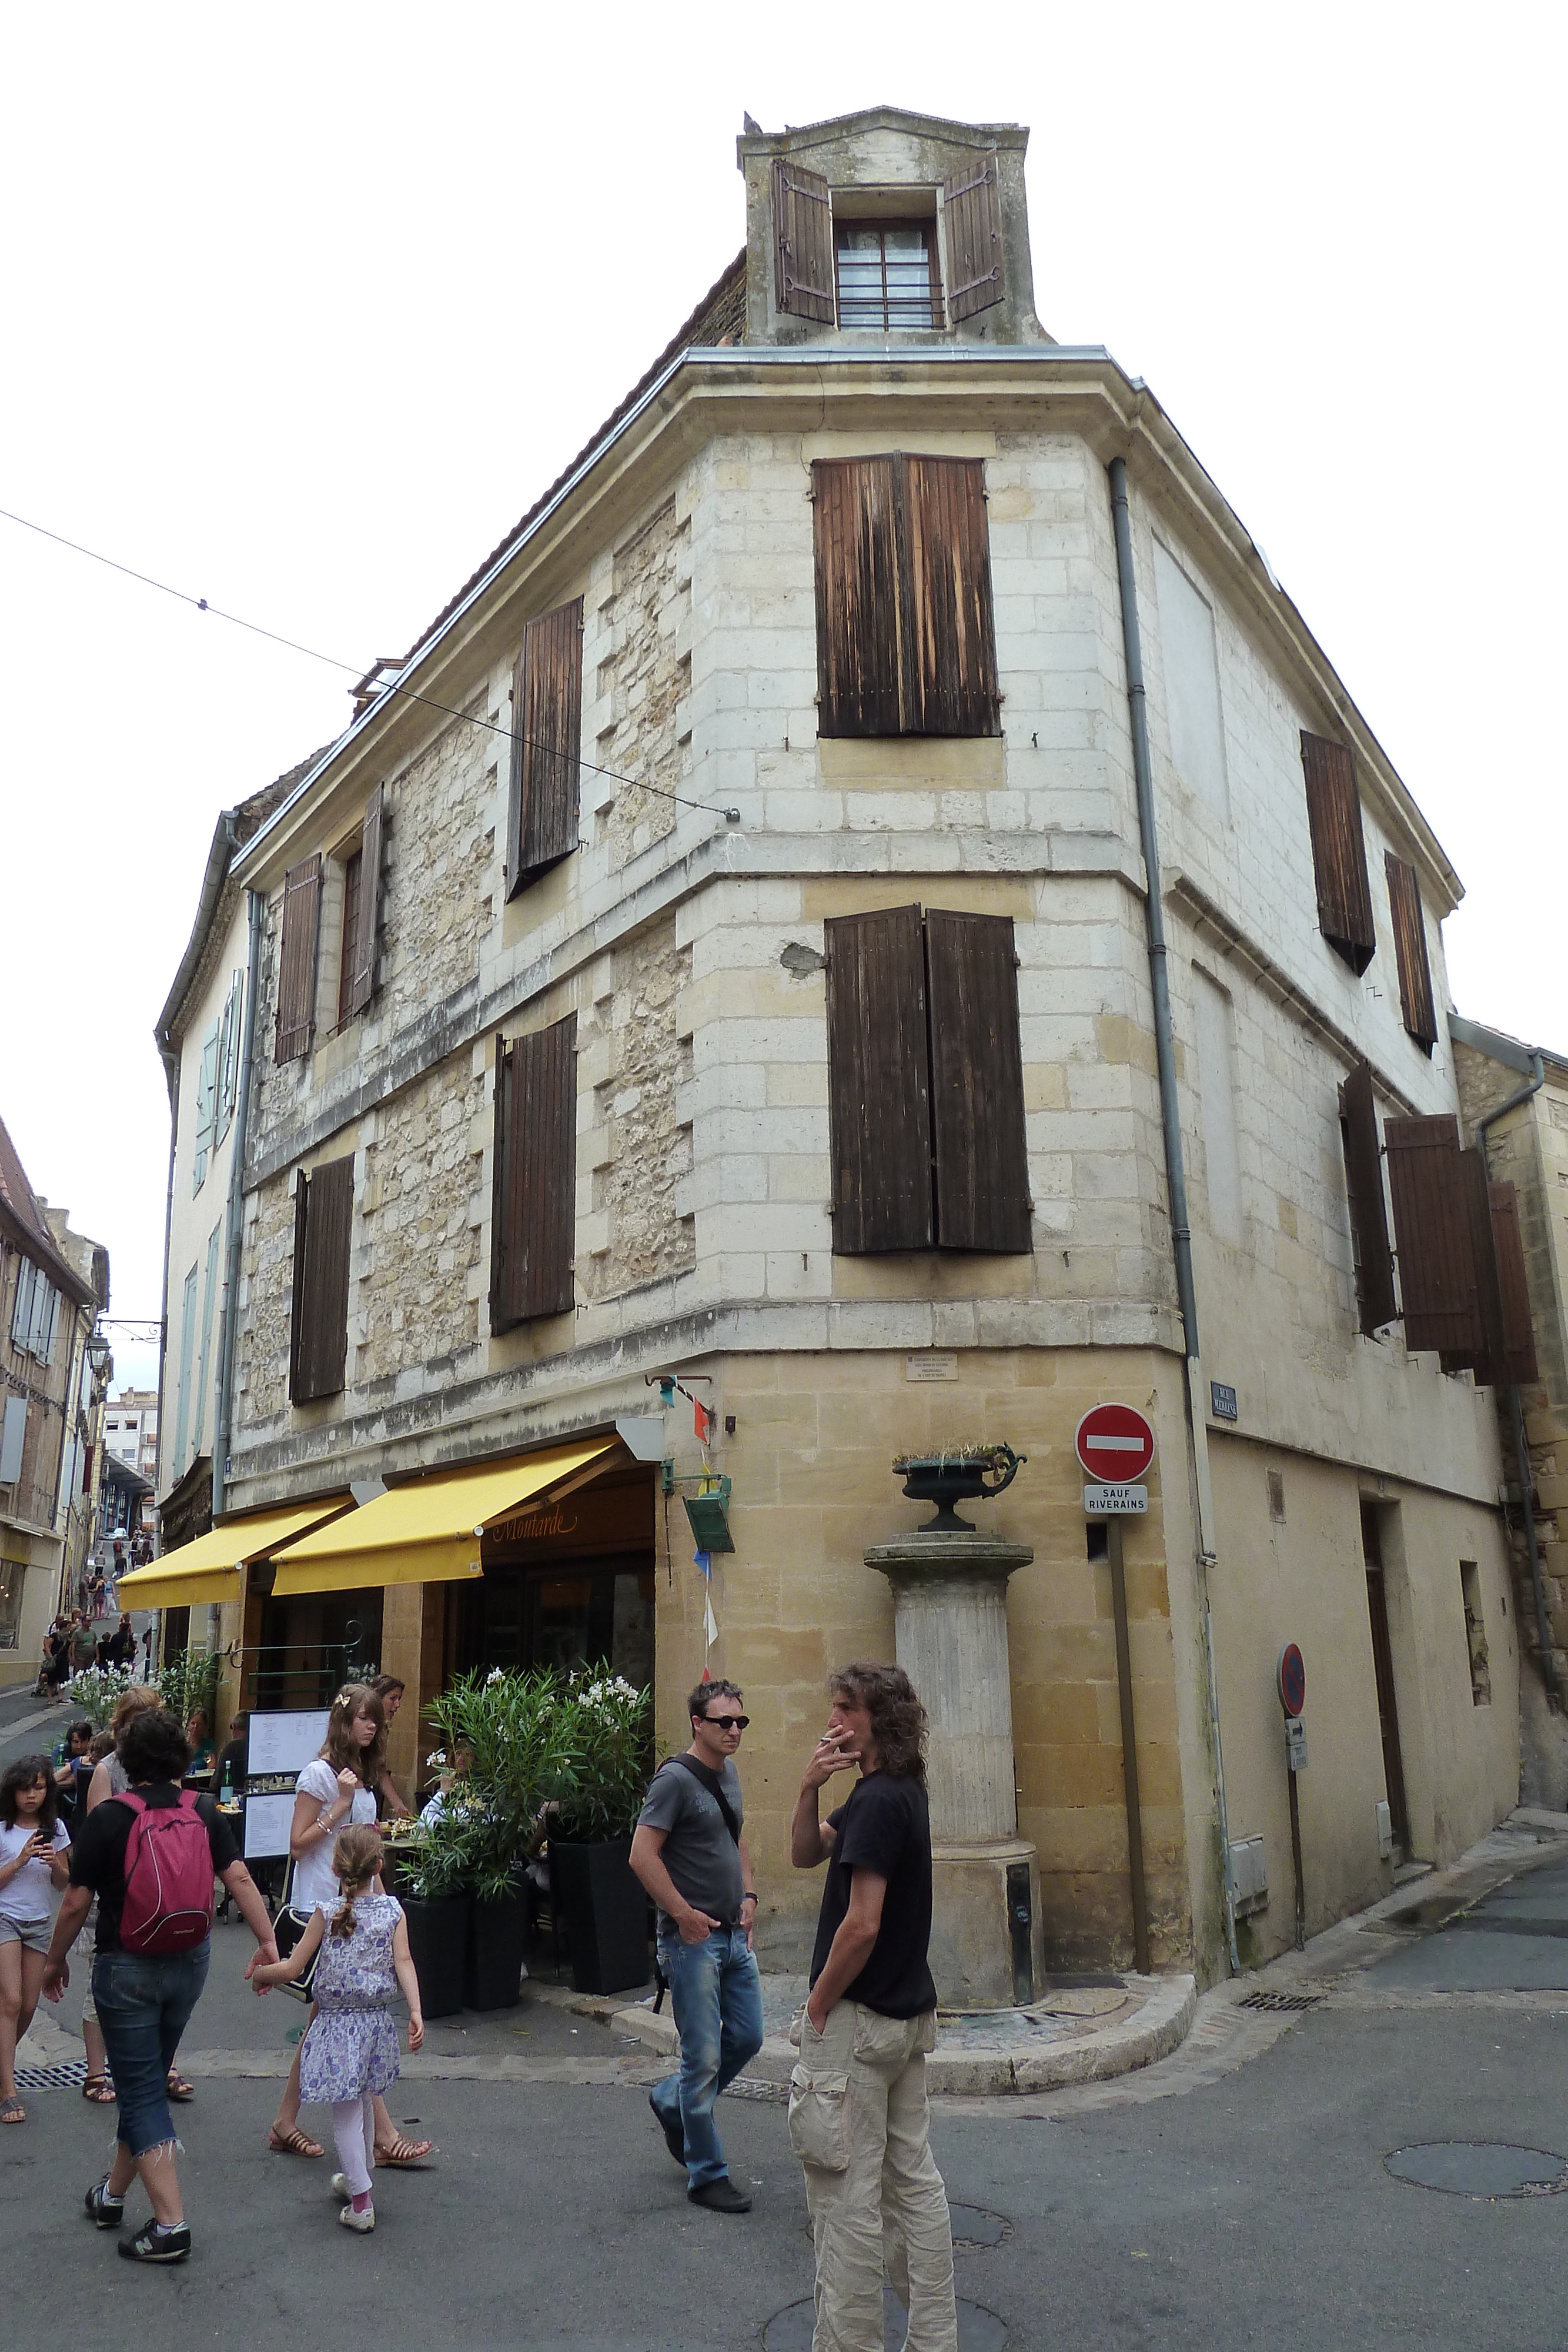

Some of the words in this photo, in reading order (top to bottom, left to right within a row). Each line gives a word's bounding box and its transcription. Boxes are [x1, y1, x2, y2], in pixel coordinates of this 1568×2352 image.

[1219, 1388, 1229, 1399] RUE
[1102, 1489, 1130, 1498] SAUF
[1089, 1499, 1144, 1509] RIVERAINS
[493, 1504, 578, 1542] Moutarde
[135, 2236, 153, 2255] N
